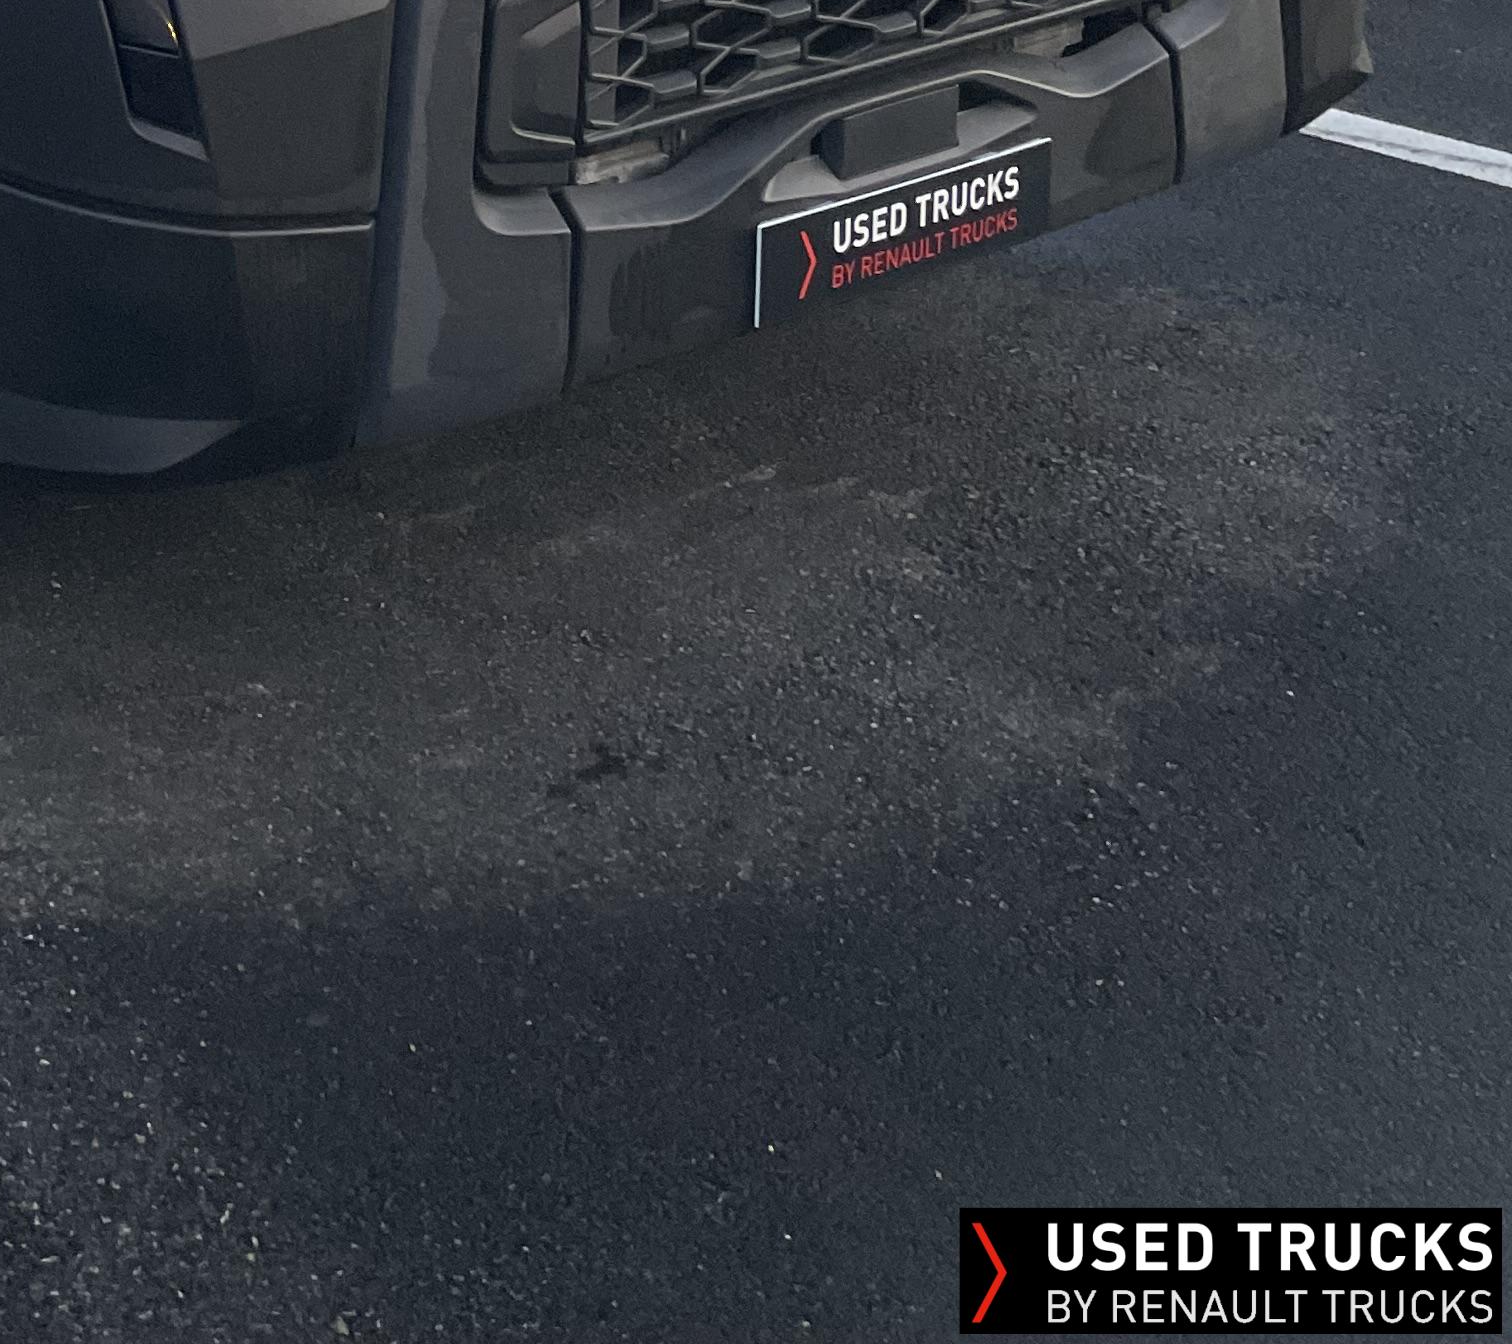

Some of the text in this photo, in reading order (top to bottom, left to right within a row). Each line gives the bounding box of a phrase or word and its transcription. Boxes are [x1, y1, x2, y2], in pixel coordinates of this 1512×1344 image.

[830, 207, 1018, 289] BY RENAULT TRUCKS
[832, 165, 1020, 254] USED TRUCKS
